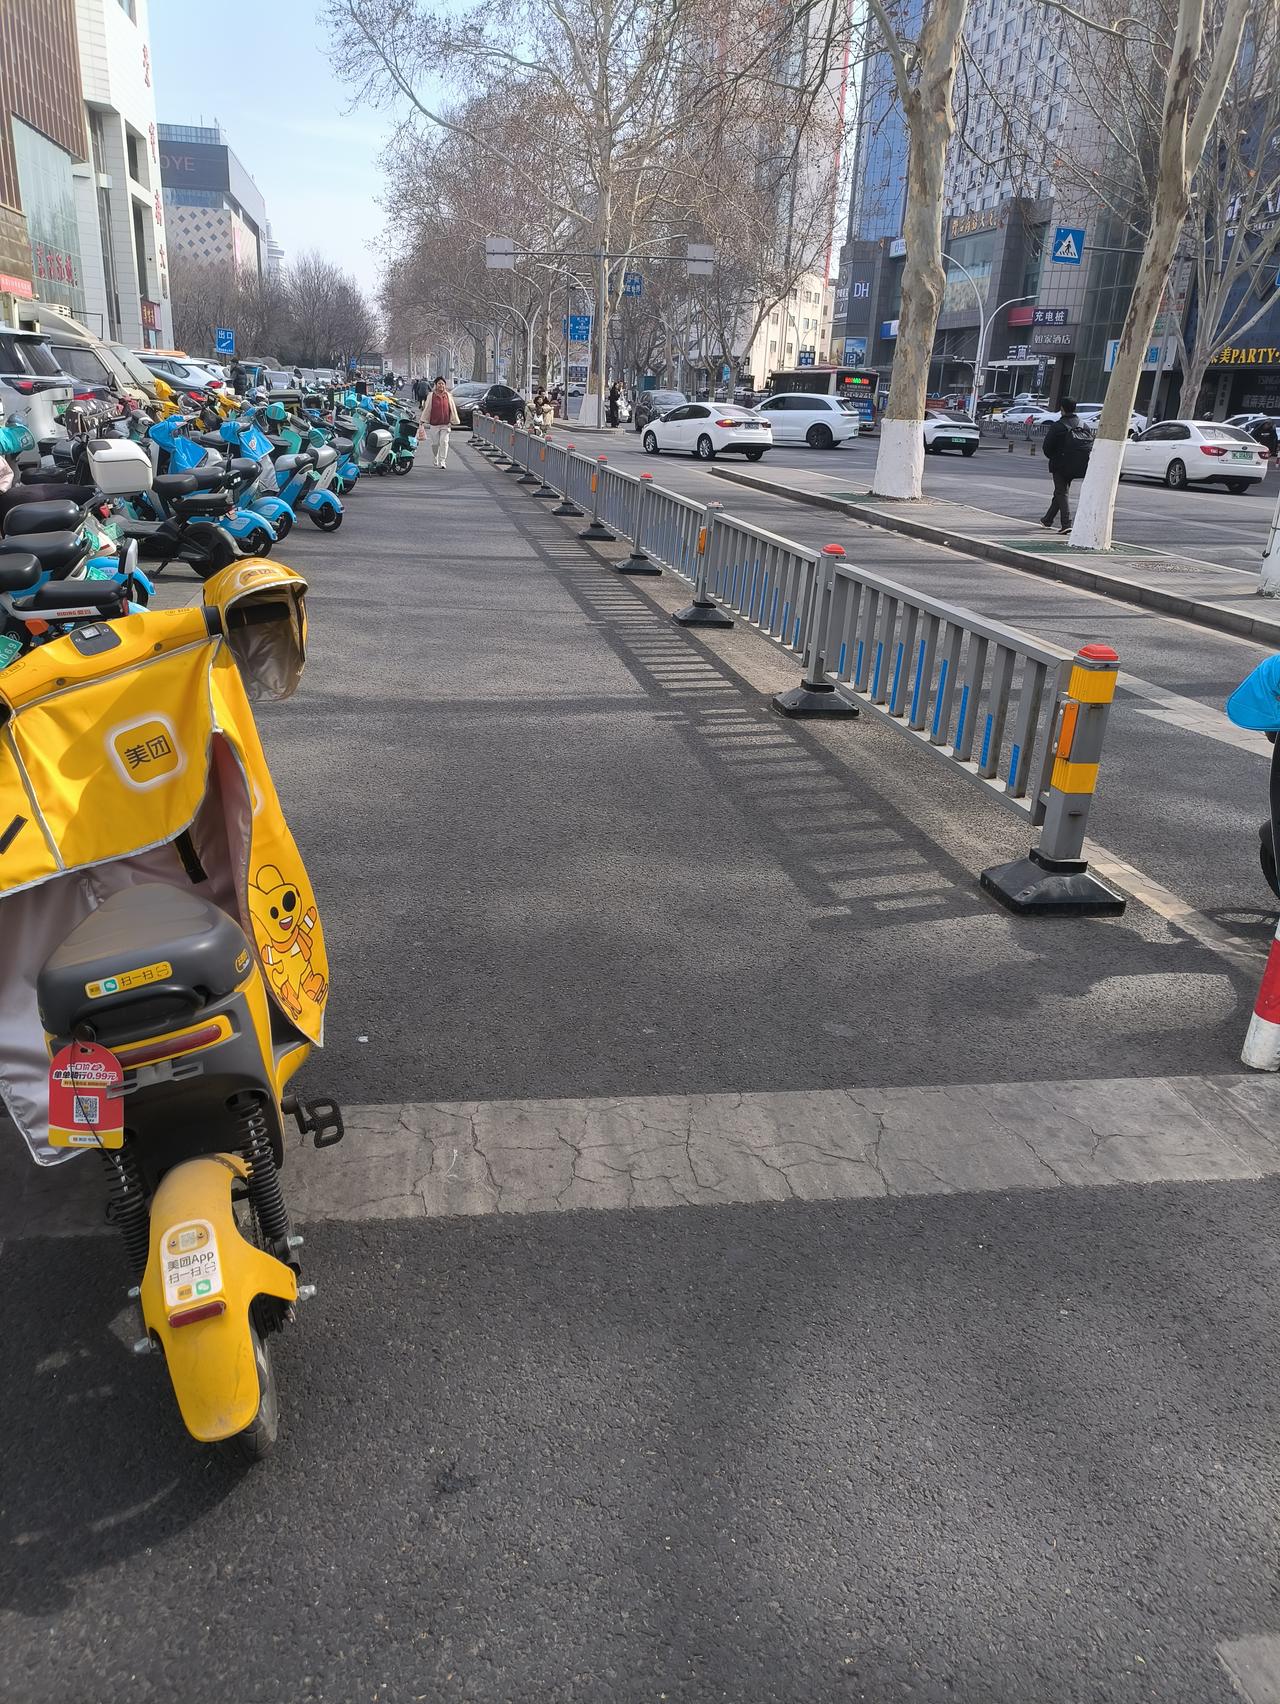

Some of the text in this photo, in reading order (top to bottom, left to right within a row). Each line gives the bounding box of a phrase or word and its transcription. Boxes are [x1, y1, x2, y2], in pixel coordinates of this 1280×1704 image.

[854, 282, 870, 298] DH
[1034, 310, 1065, 322] 充电桩
[218, 330, 233, 339] 出口
[124, 735, 172, 770] 美团
[121, 970, 154, 987] 扫一扫
[168, 1251, 215, 1272] 美团App
[169, 1266, 202, 1285] 扫一扫
